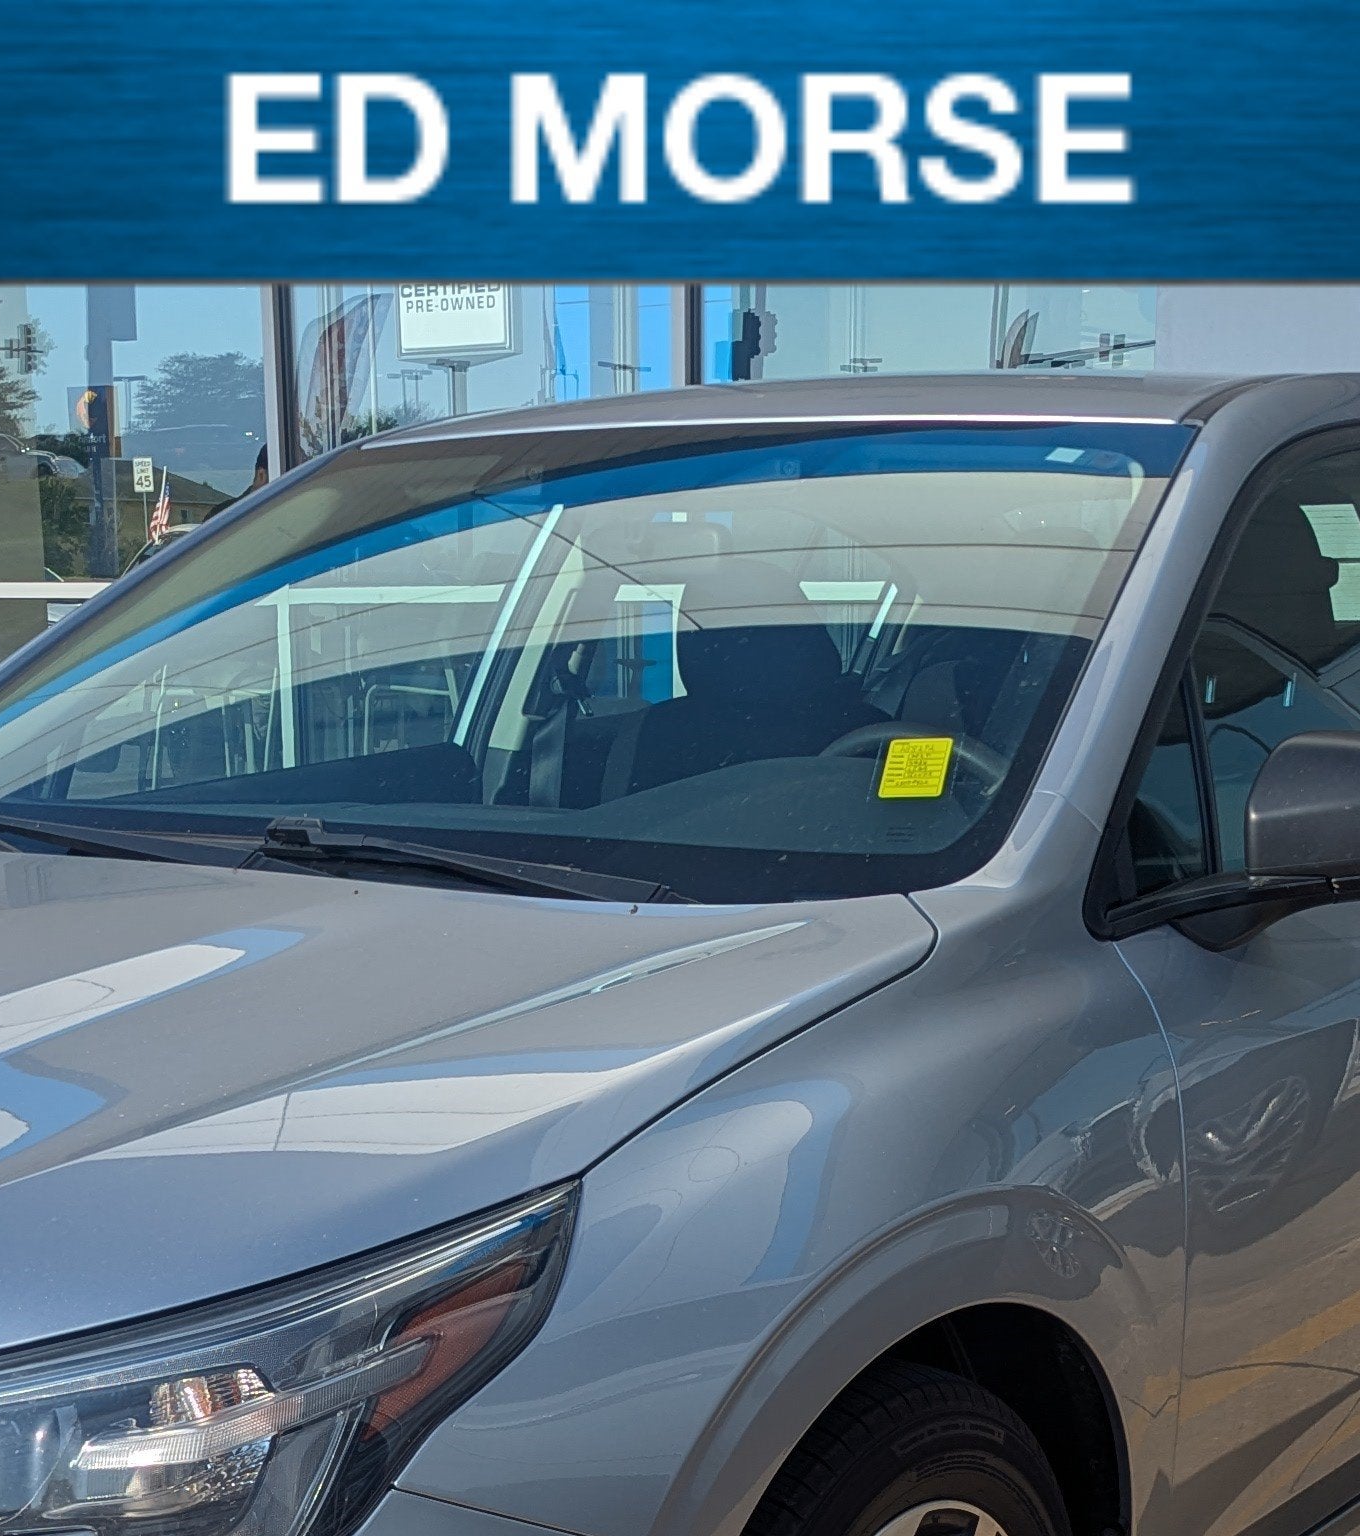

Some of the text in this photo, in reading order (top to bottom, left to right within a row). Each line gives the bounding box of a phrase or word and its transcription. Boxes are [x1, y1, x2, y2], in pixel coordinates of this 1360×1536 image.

[400, 282, 501, 298] CERTIFIED
[406, 295, 496, 313] PRE-OWNED
[136, 475, 152, 488] 45
